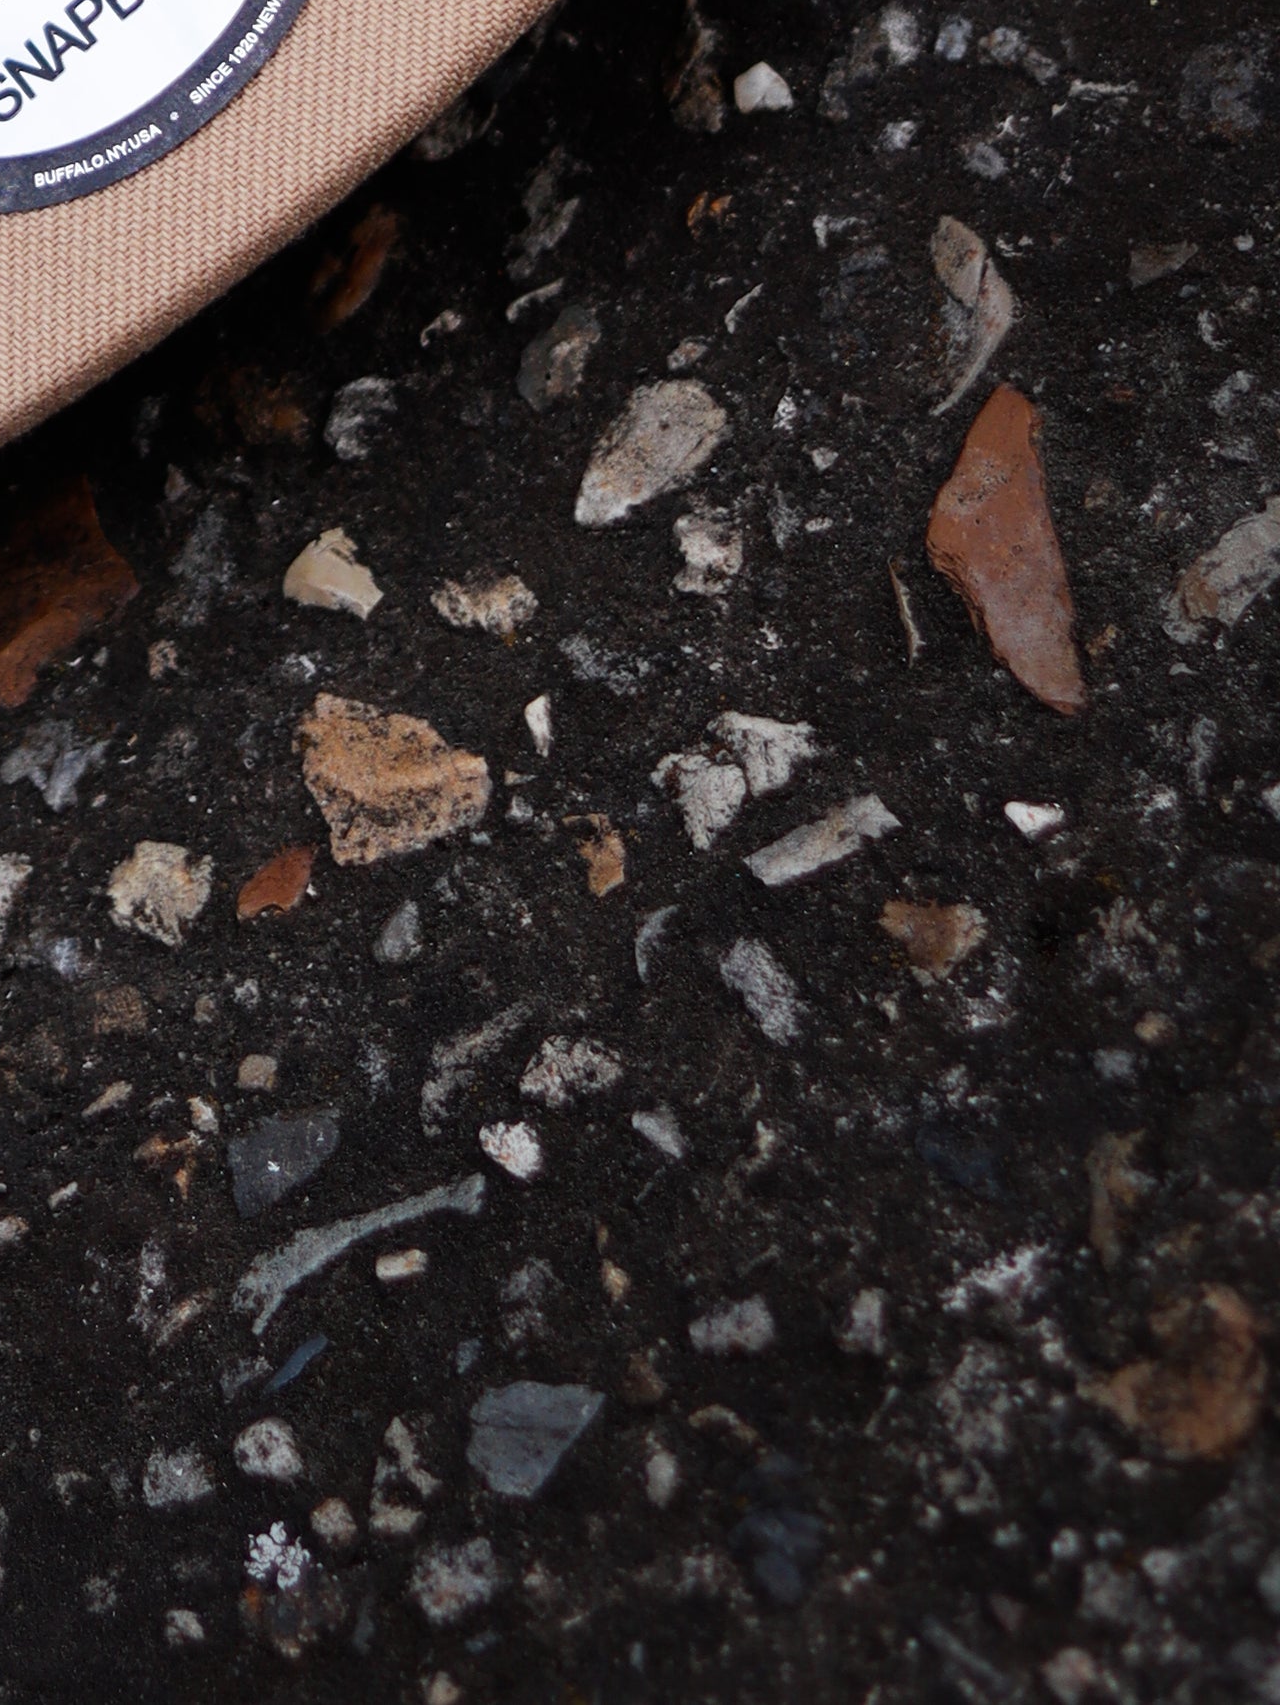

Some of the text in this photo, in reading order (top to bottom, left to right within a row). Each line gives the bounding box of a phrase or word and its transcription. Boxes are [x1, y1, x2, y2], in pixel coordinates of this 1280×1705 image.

[33, 123, 162, 188] BUFFALO.NY.USA
[189, 61, 234, 105] SINCE
[228, 31, 260, 65] 1920
